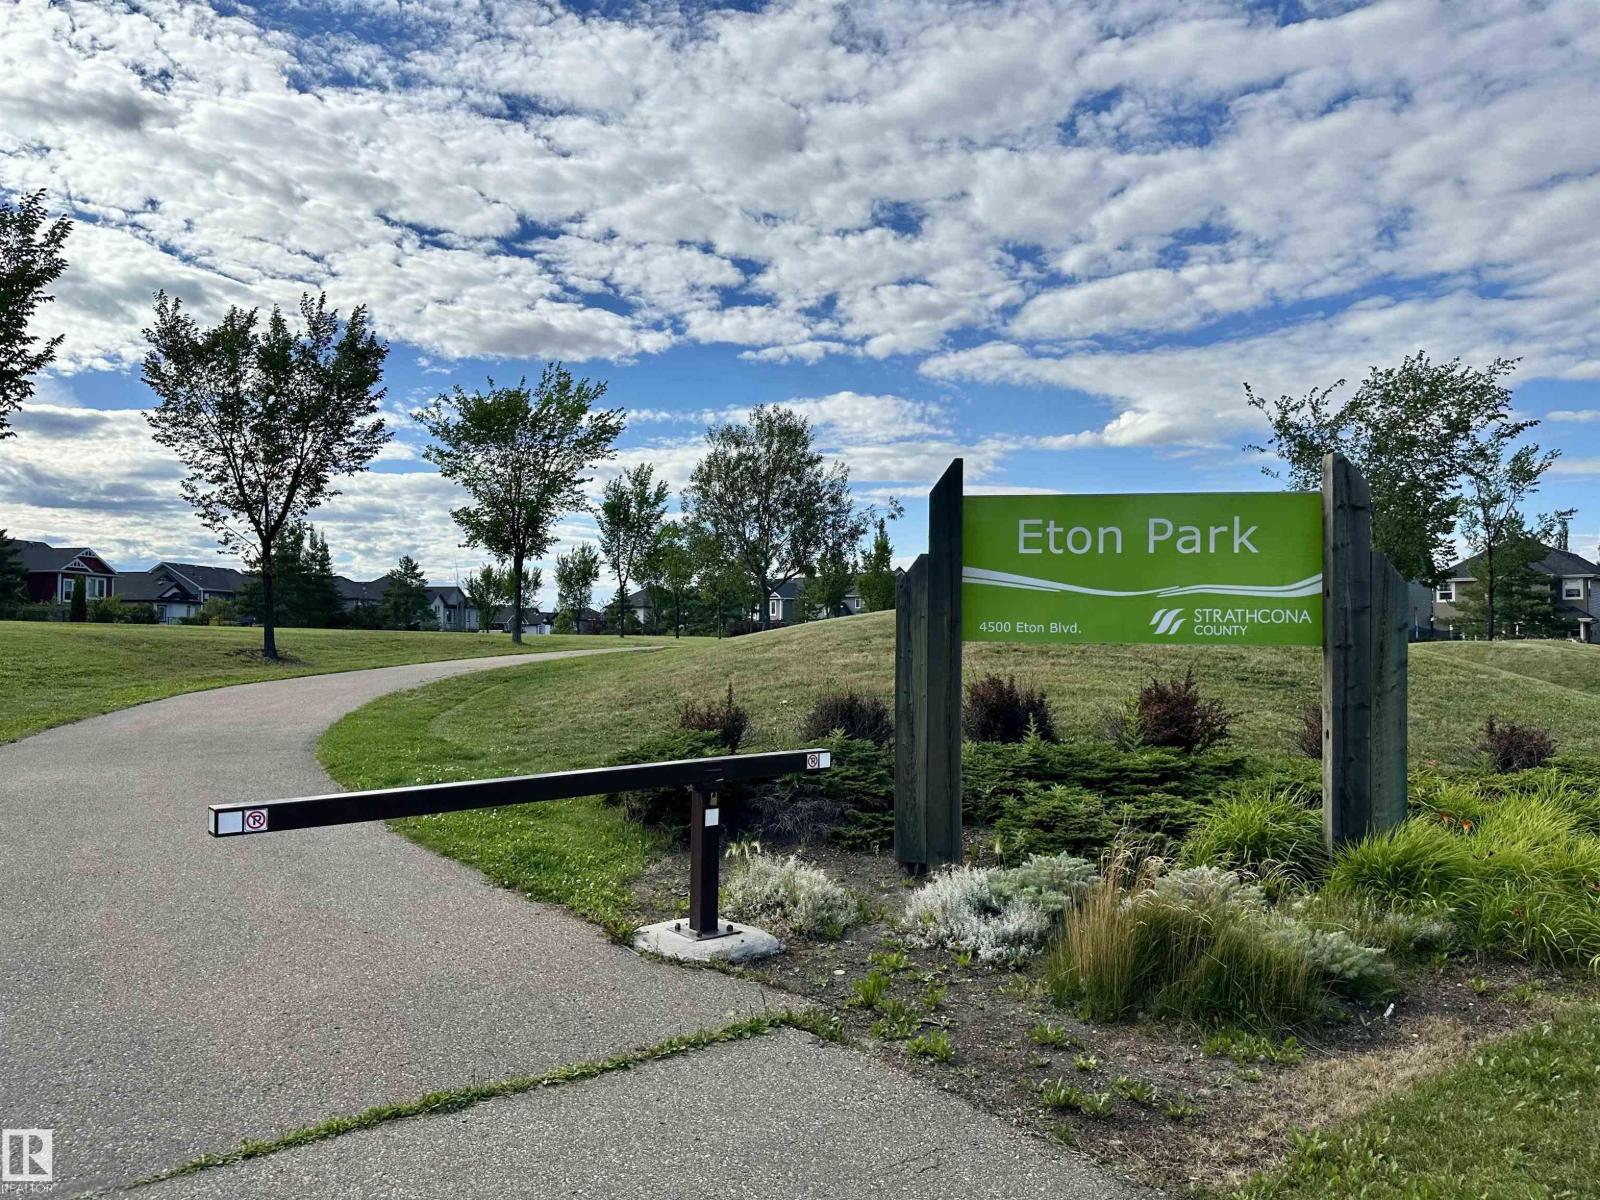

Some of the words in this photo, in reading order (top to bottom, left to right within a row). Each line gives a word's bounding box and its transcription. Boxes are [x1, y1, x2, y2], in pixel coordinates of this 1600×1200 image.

[1017, 518, 1123, 554] Eton
[1147, 515, 1260, 554] Park
[1193, 608, 1312, 624] STRATHCONA
[979, 621, 1012, 633] 4500
[1016, 622, 1045, 633] Eton
[1049, 622, 1082, 634] Blvd.
[1193, 625, 1248, 636] COUNTY
